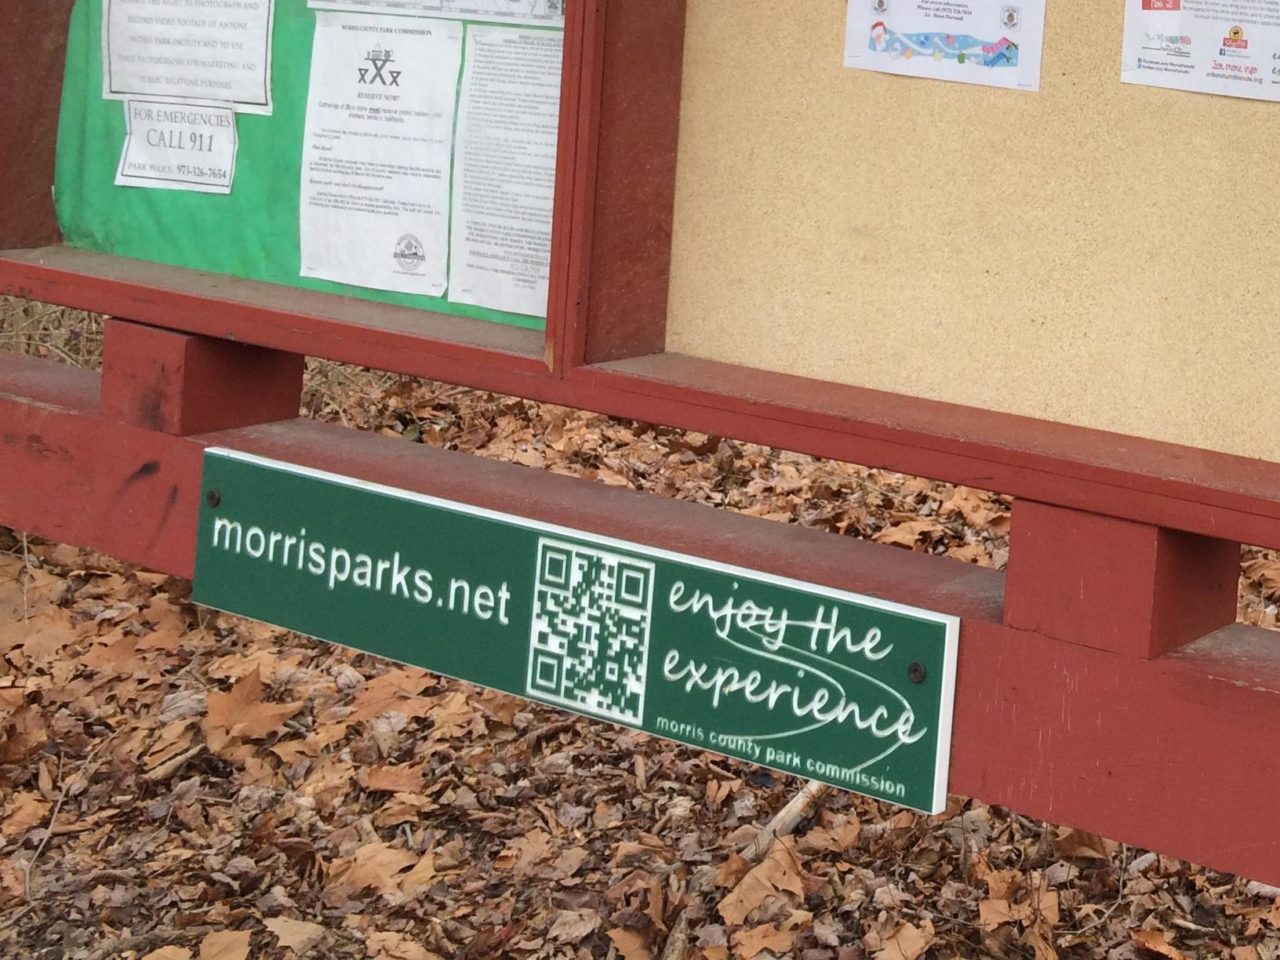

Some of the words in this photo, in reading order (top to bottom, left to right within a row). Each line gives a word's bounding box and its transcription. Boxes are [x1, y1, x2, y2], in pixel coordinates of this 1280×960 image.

[133, 107, 154, 122] FOR
[157, 109, 231, 127] EMERGENCIES
[147, 129, 183, 149] CALL
[190, 131, 213, 152] 911
[213, 517, 510, 625] morrisparks.net
[668, 579, 789, 649] enjoy
[810, 605, 892, 661] the
[664, 648, 927, 746] experience
[657, 717, 704, 740] morris
[710, 732, 761, 759] county
[766, 747, 800, 768] park
[807, 759, 905, 797] commission
